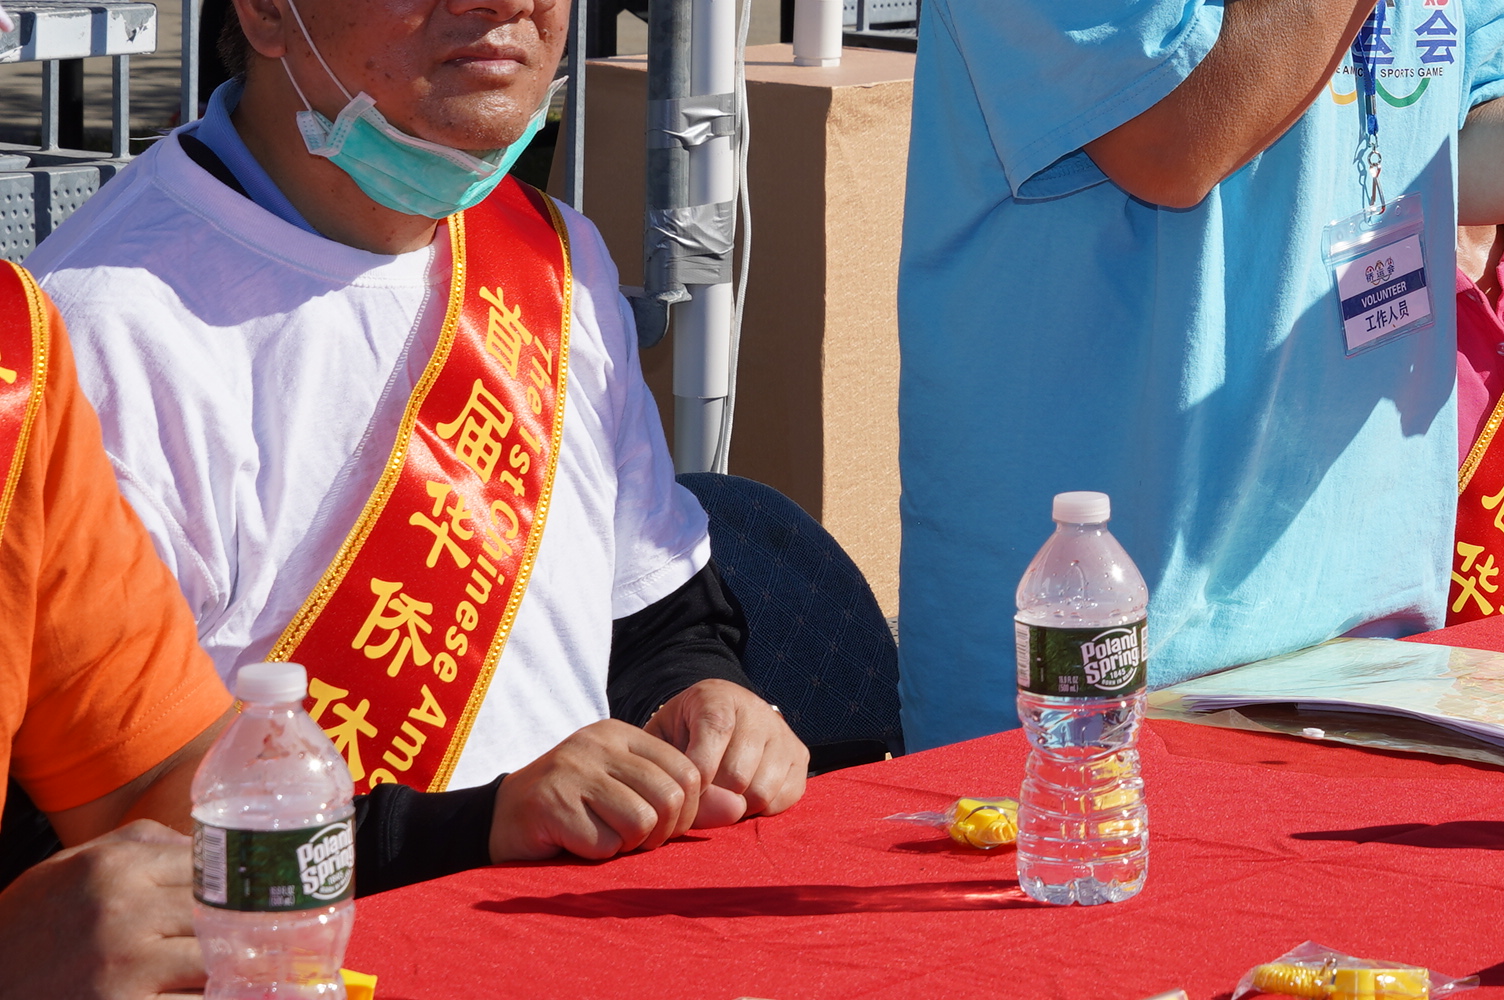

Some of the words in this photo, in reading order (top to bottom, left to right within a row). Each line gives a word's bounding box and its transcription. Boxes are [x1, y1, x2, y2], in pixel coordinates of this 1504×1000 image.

[1380, 67, 1415, 78] SPORTS
[1417, 66, 1444, 78] GAME
[1365, 264, 1395, 283] 侨运会
[1361, 281, 1407, 308] VOLUNTEER
[1365, 300, 1409, 332] 工作人员
[527, 336, 552, 415] The
[500, 426, 542, 497] 1st
[433, 500, 519, 683] Chinese
[1080, 626, 1139, 664] Poland
[1084, 646, 1140, 685] Spring
[1110, 668, 1127, 678] 1845
[296, 819, 353, 872] Poland
[301, 844, 354, 895] Spring
